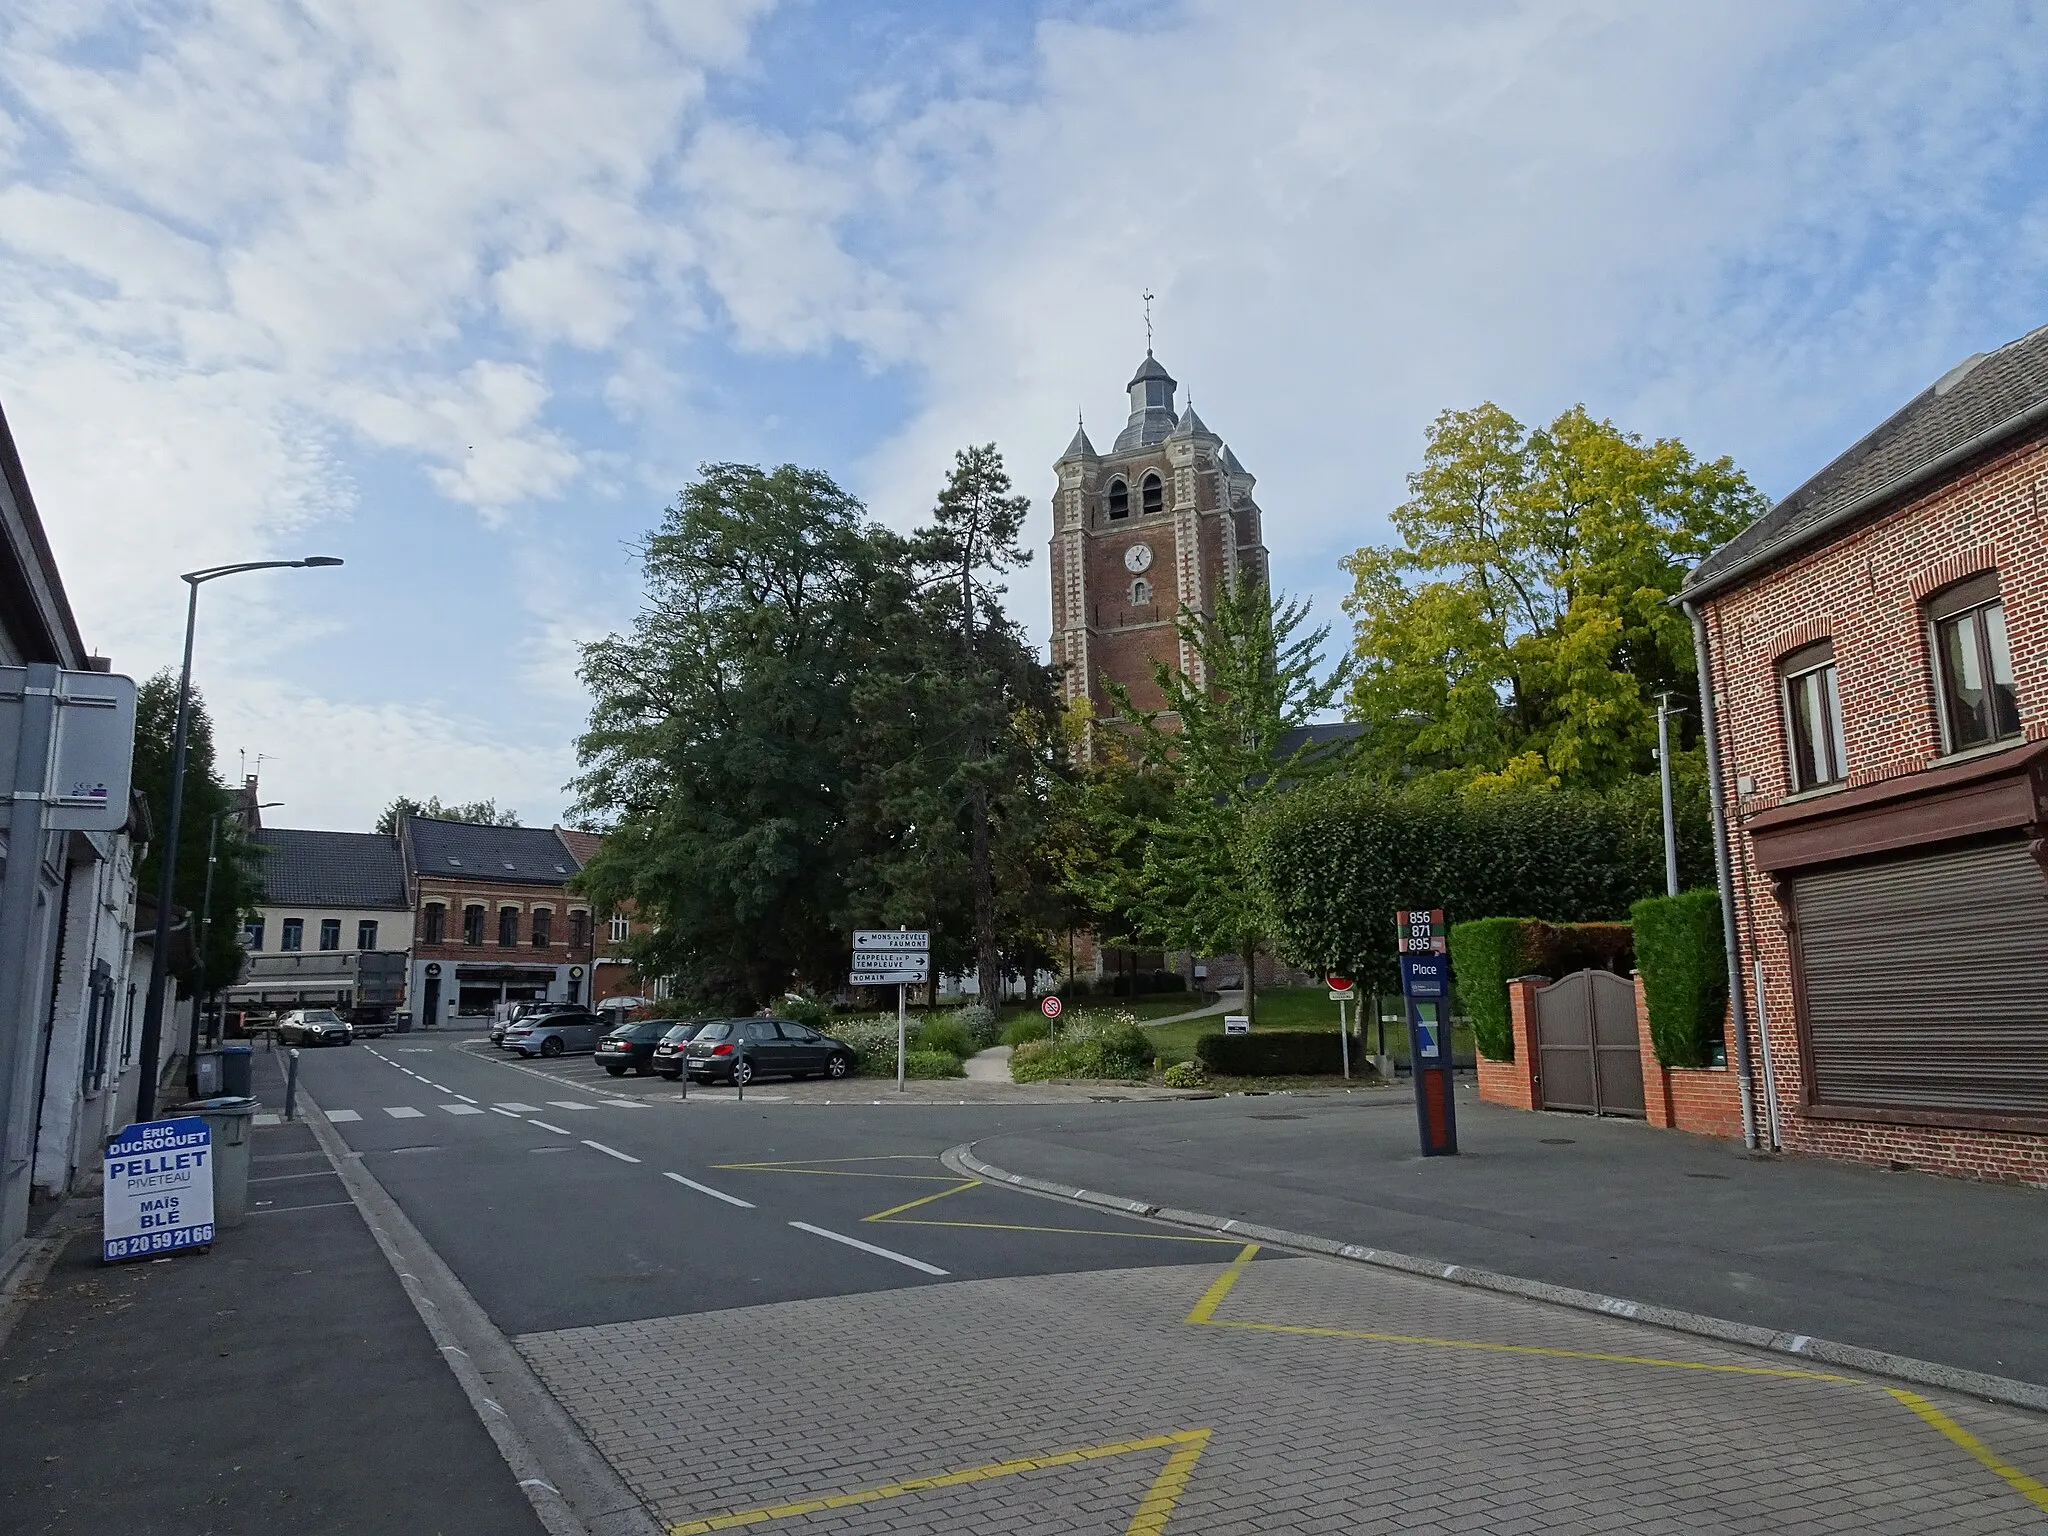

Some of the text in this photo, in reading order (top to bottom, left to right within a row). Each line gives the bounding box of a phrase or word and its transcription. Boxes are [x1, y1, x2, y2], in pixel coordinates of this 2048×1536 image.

[1409, 911, 1431, 924] 856
[1411, 925, 1431, 937] 871
[1408, 938, 1430, 951] 895
[1412, 963, 1437, 975] Place
[142, 1126, 174, 1139] ÉRIC
[108, 1132, 207, 1155] DUCROQUET
[110, 1151, 207, 1179] PELLET
[127, 1171, 191, 1189] PIVETEAU
[140, 1196, 180, 1213] MAÏS
[140, 1208, 180, 1228] BLÉ
[107, 1225, 213, 1257] 03 20 59 21 66
